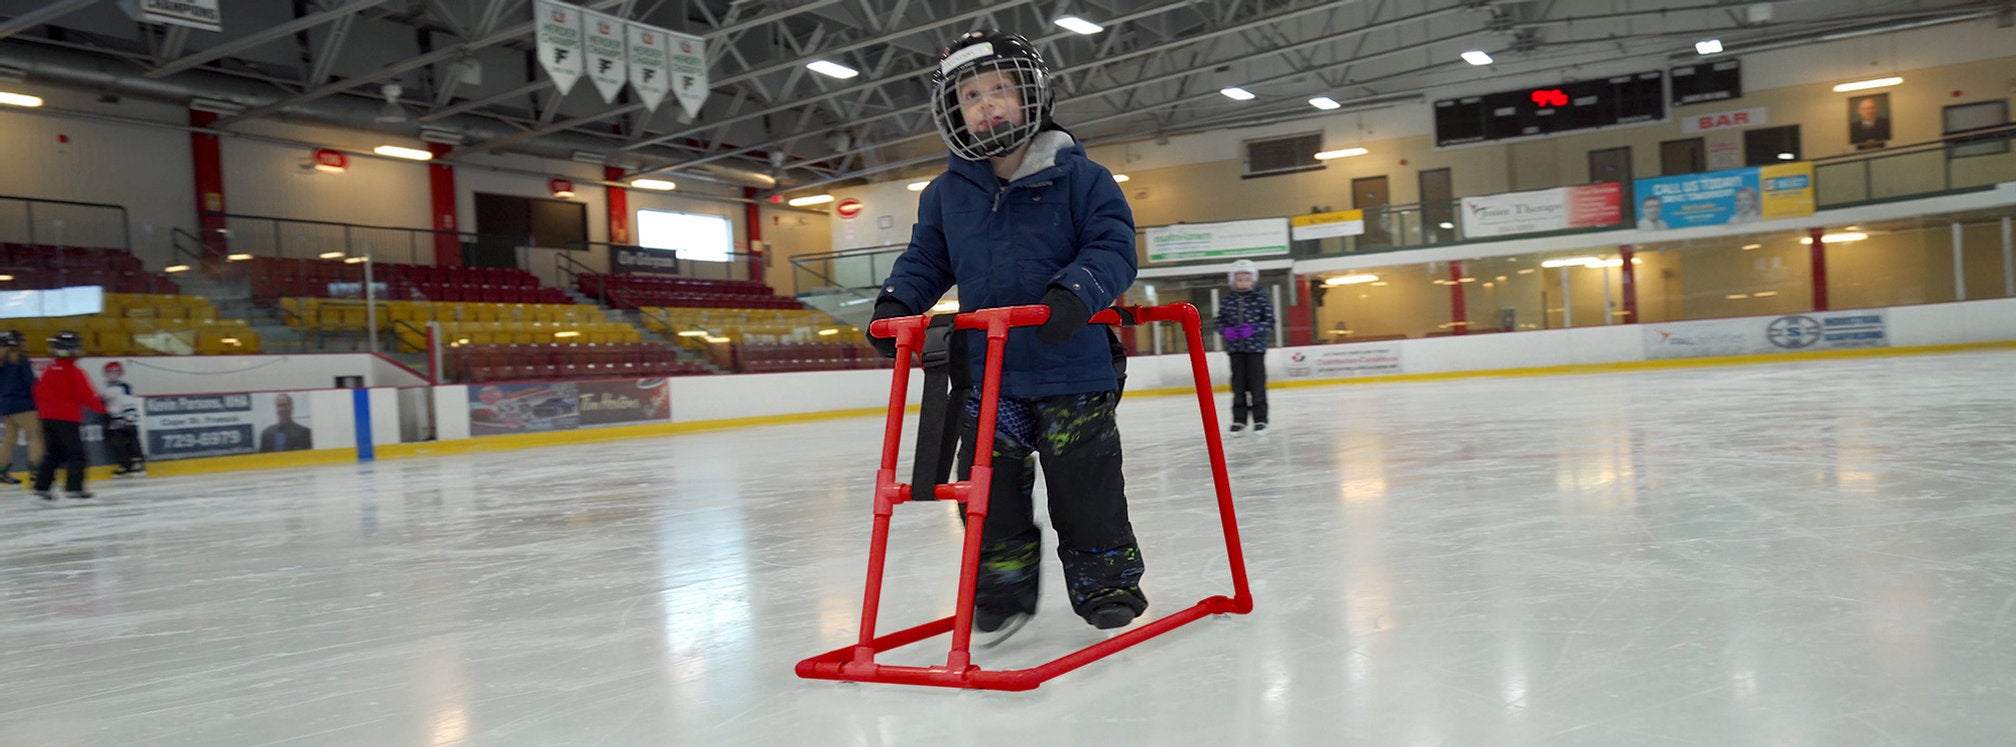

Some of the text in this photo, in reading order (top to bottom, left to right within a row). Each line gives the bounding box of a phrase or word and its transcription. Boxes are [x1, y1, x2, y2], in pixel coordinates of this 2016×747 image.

[1699, 112, 1750, 129] BAR
[1653, 183, 1681, 196] CALL
[1682, 180, 1699, 192] US
[1786, 326, 1801, 337] S
[579, 392, 641, 411] Tim Hortons
